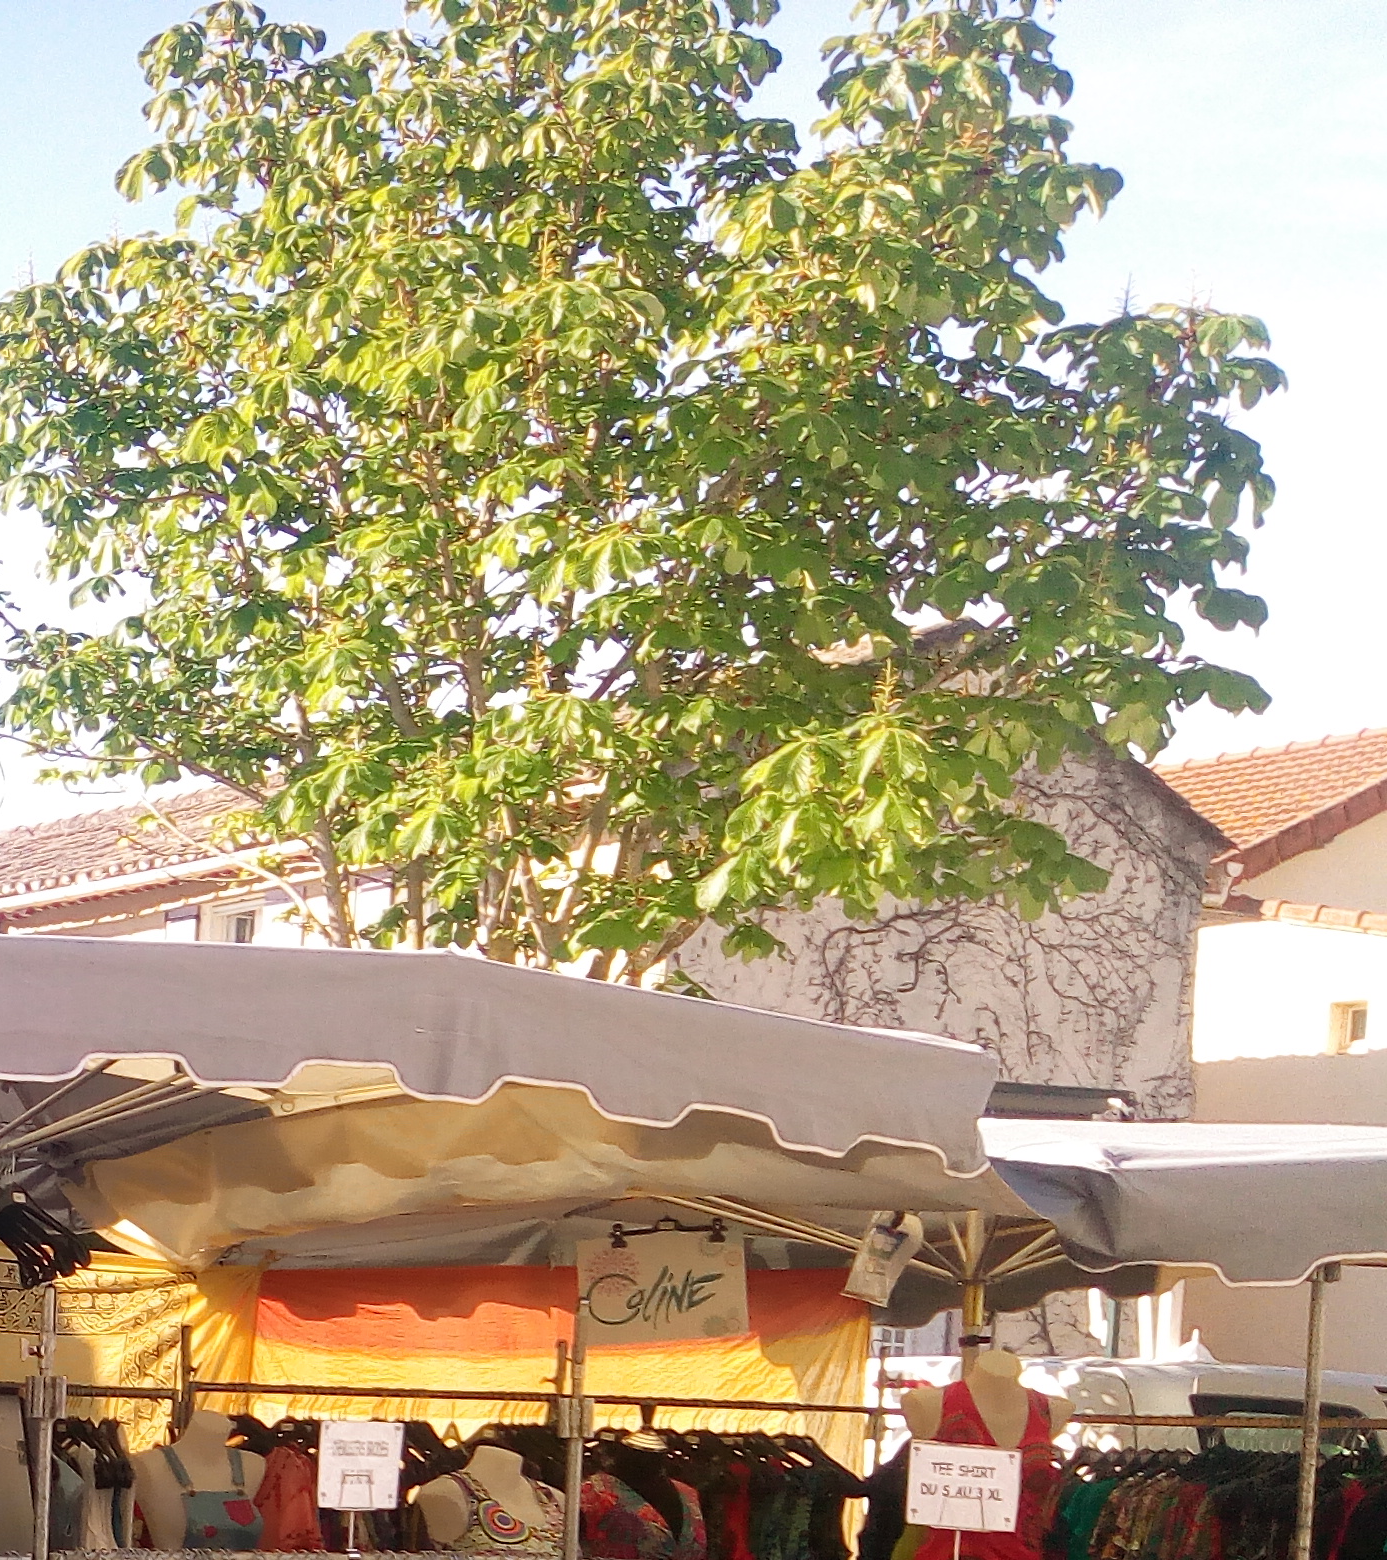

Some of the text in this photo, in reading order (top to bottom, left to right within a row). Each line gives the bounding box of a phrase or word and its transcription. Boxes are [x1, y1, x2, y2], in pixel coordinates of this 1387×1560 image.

[931, 1462, 996, 1479] TEE SHIRT
[920, 1482, 938, 1496] DU
[955, 1486, 972, 1498] AU
[976, 1487, 983, 1500] 3
[988, 1488, 1004, 1502] XL
